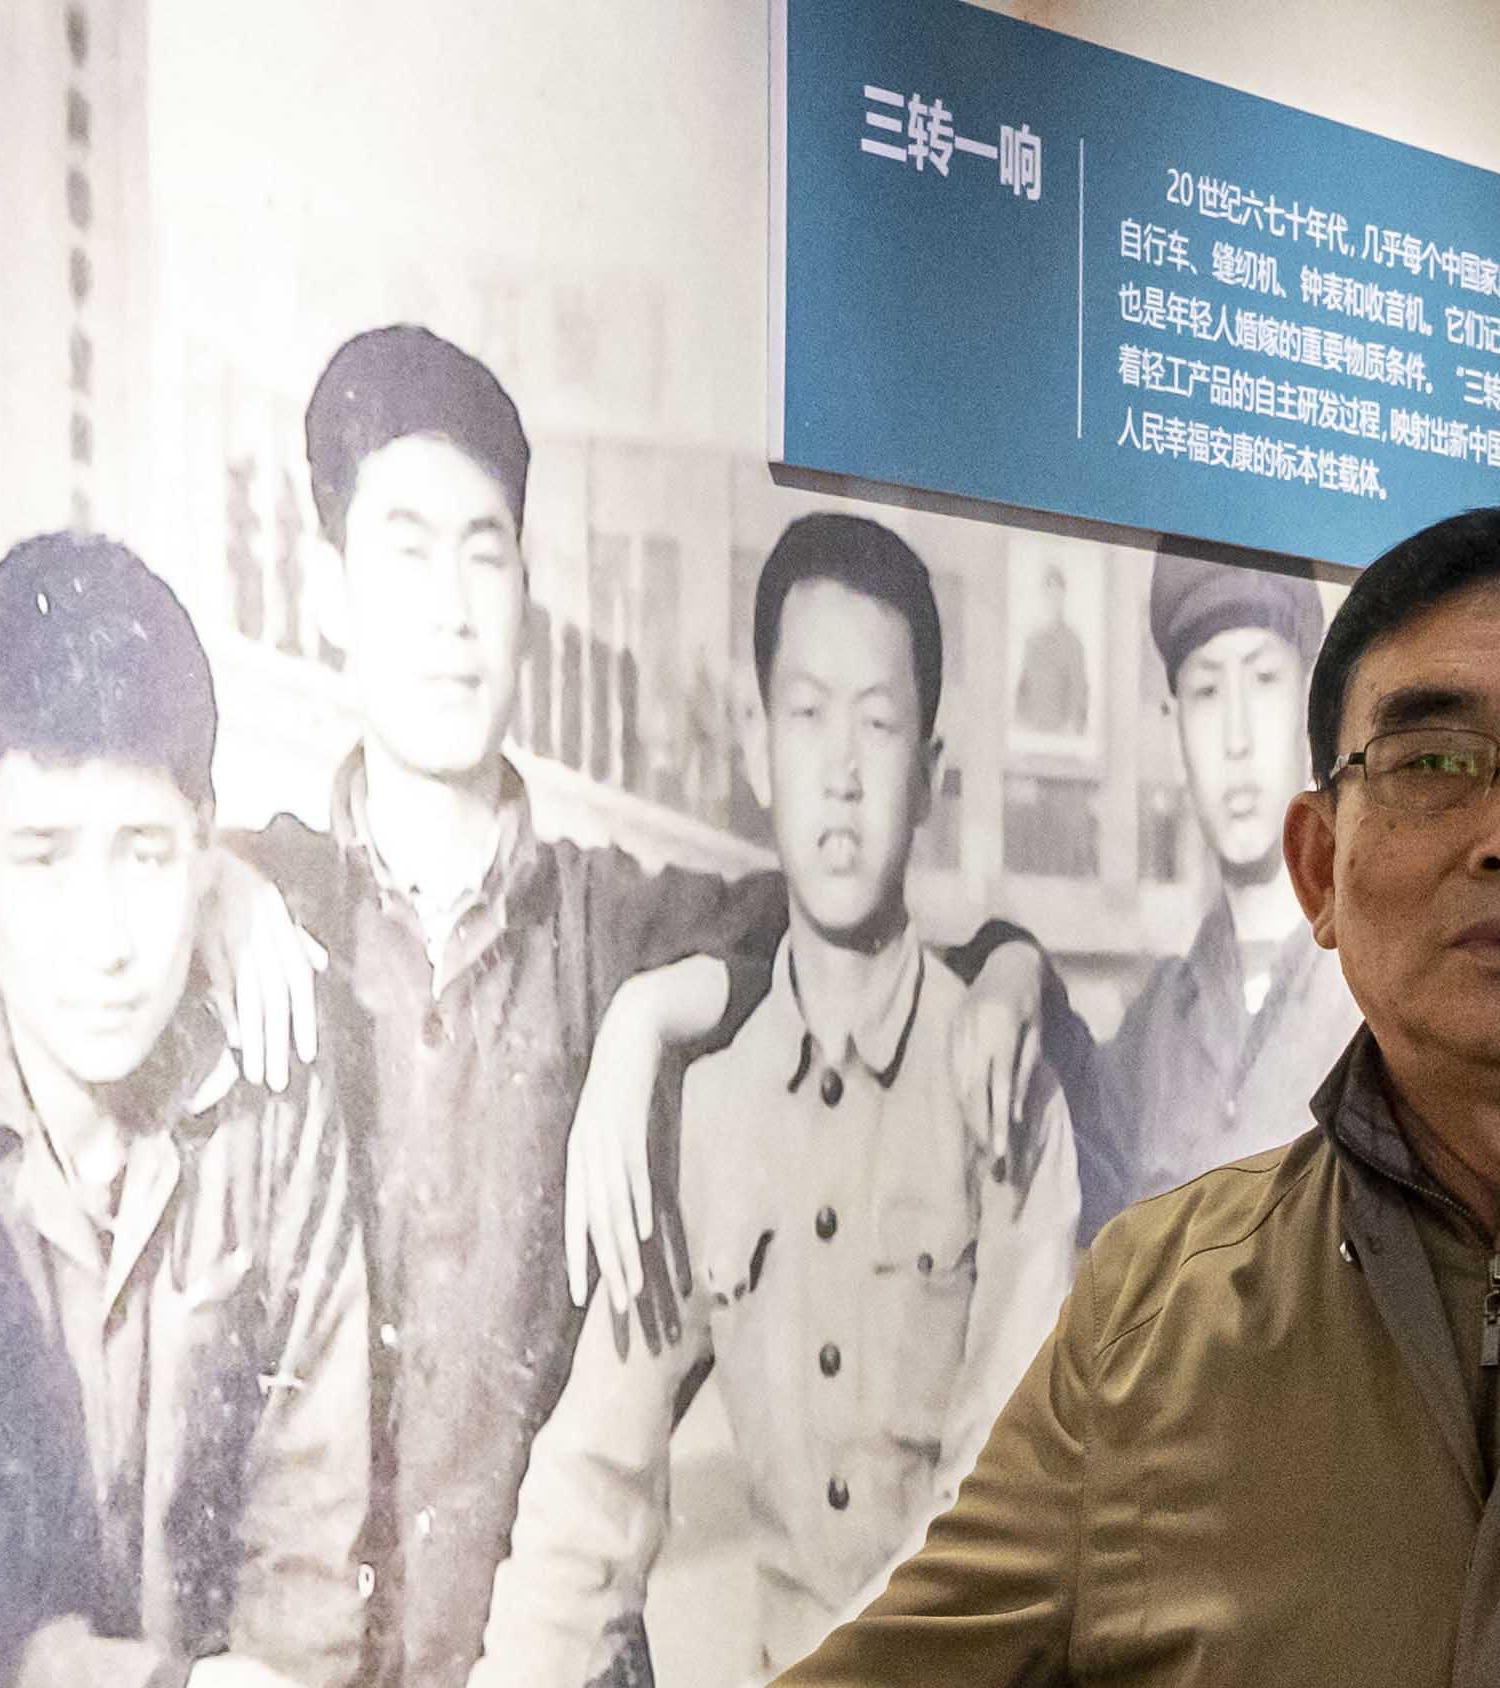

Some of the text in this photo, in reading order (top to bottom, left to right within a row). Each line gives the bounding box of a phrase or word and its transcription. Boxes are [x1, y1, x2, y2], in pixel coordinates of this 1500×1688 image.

[861, 85, 1041, 201] 三转一响
[1118, 406, 1387, 499] 人民幸福安康的标本性载体。
